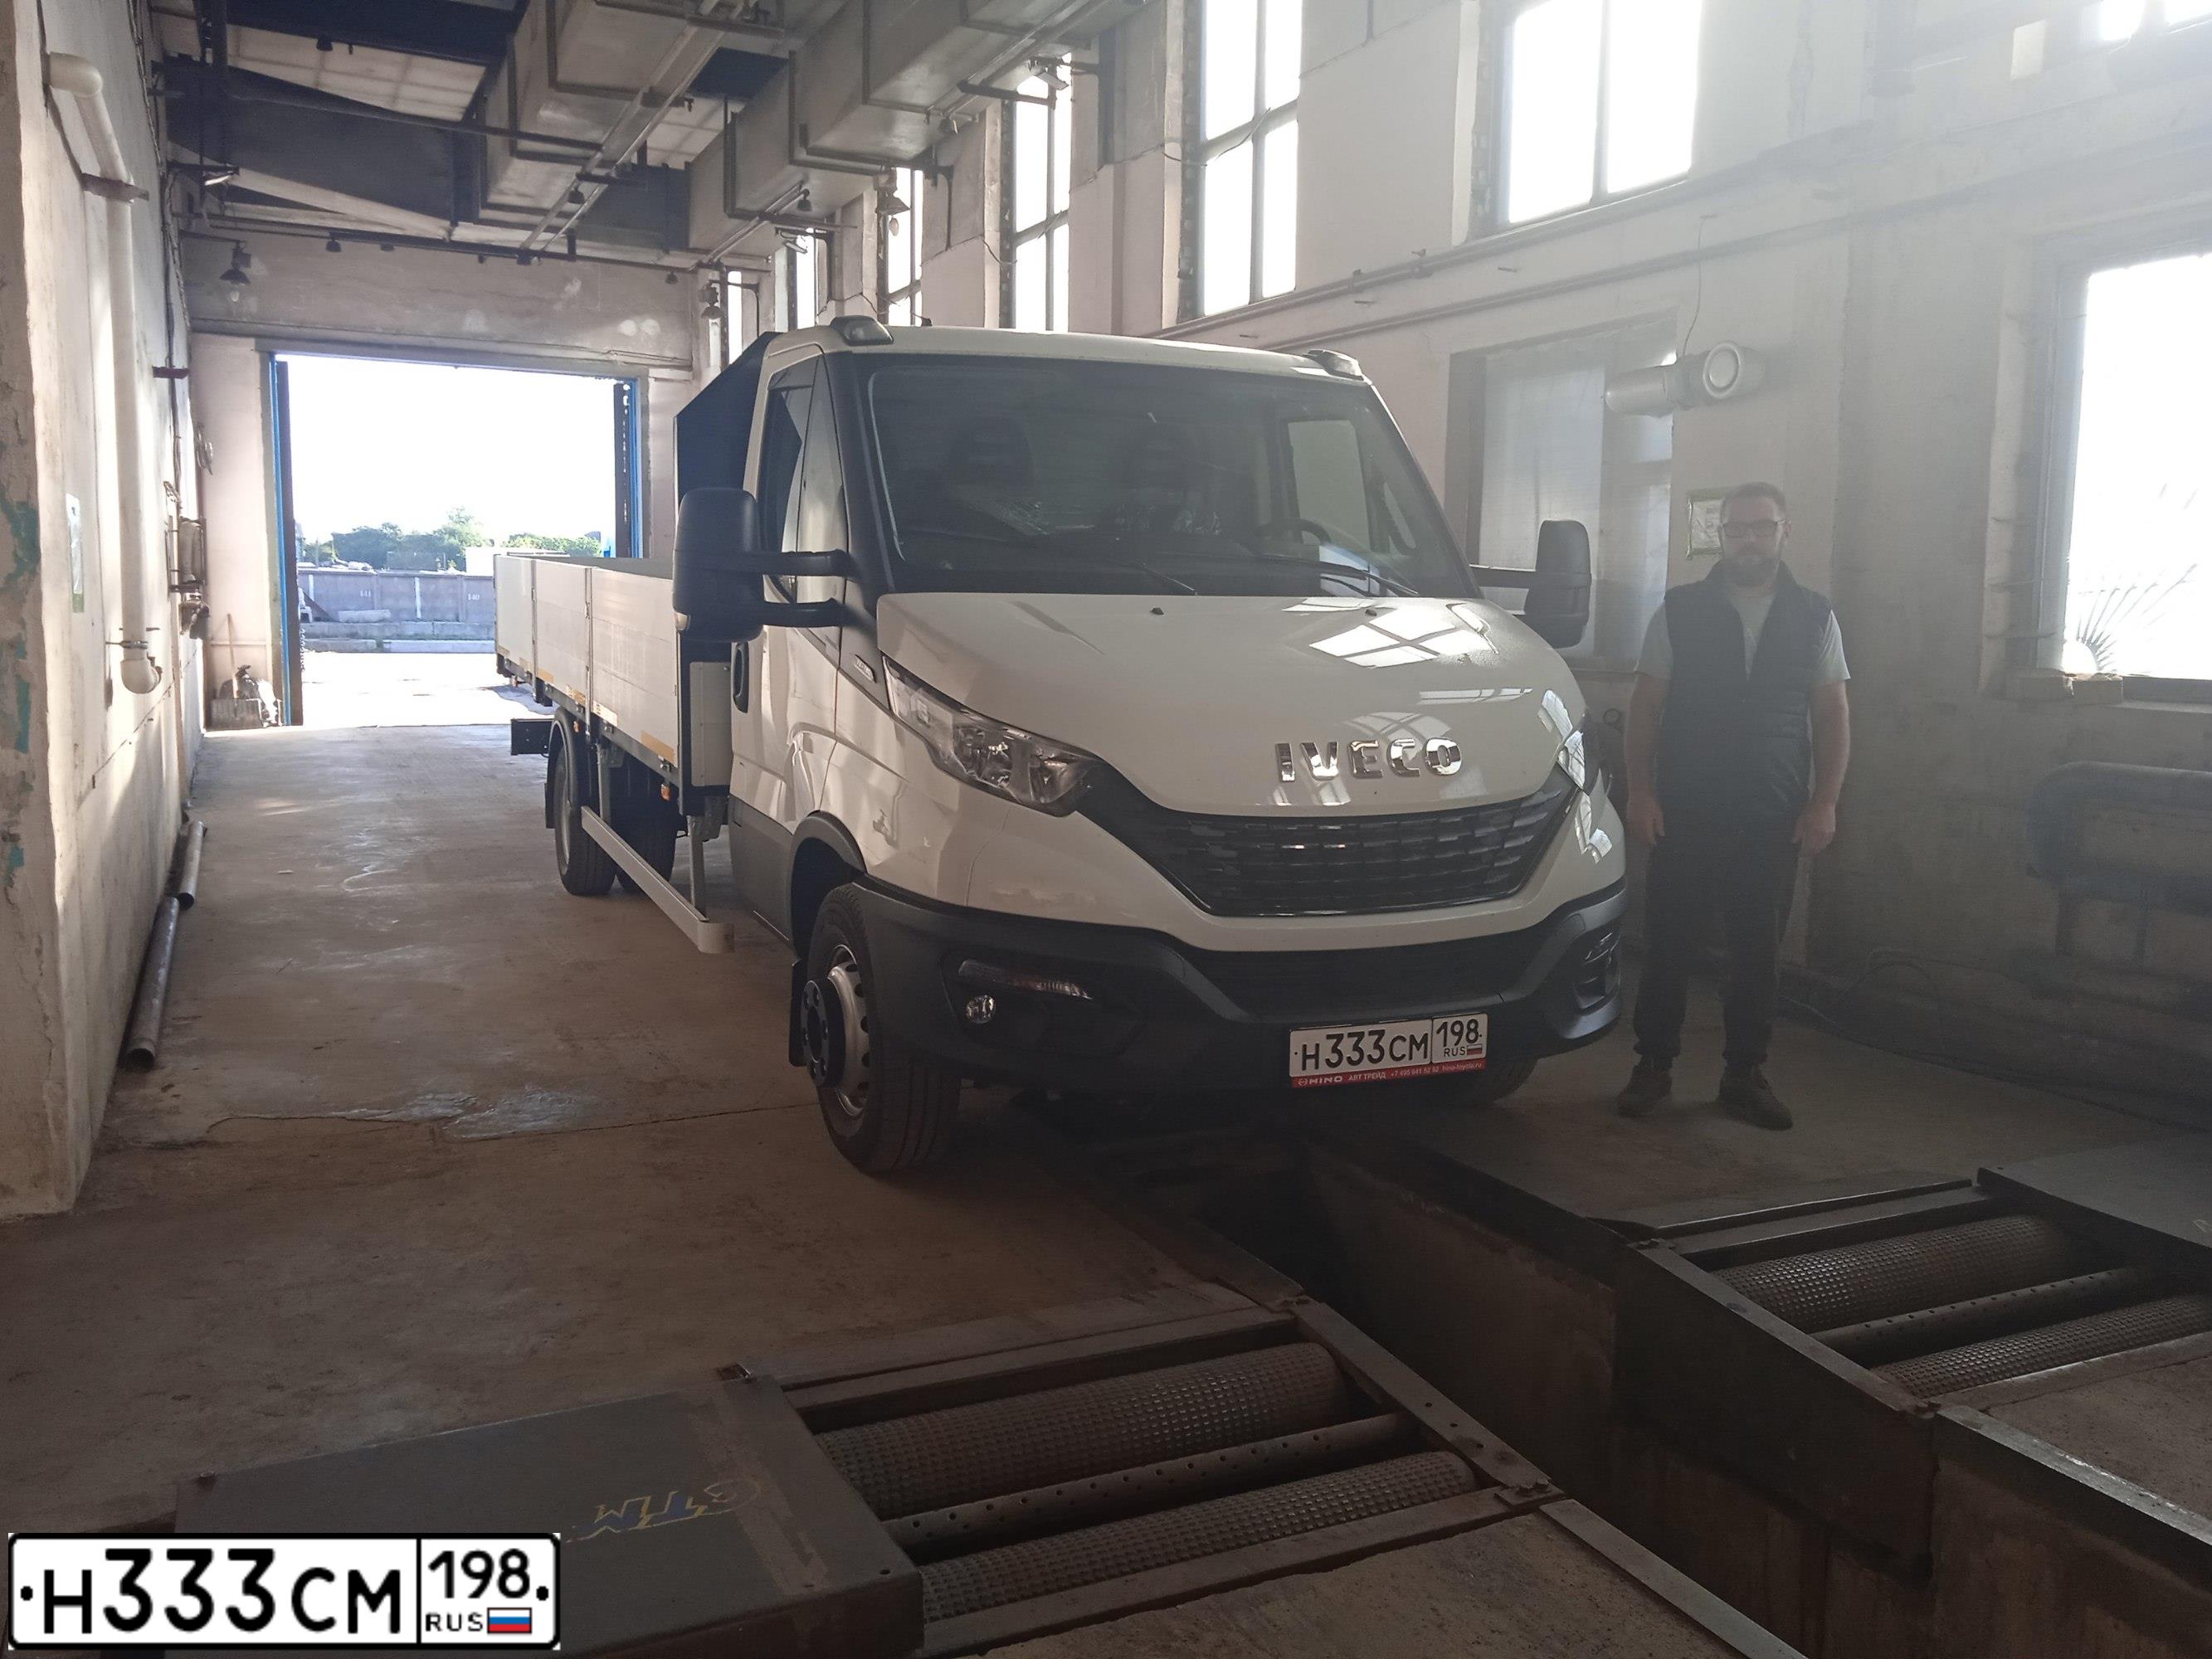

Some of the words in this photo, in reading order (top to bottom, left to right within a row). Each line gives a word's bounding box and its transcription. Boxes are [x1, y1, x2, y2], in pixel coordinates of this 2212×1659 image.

[1275, 737, 1462, 782] IVECO
[1436, 1019, 1479, 1047] 198
[1444, 1046, 1466, 1058] RUS
[1308, 1076, 1343, 1085] HINO
